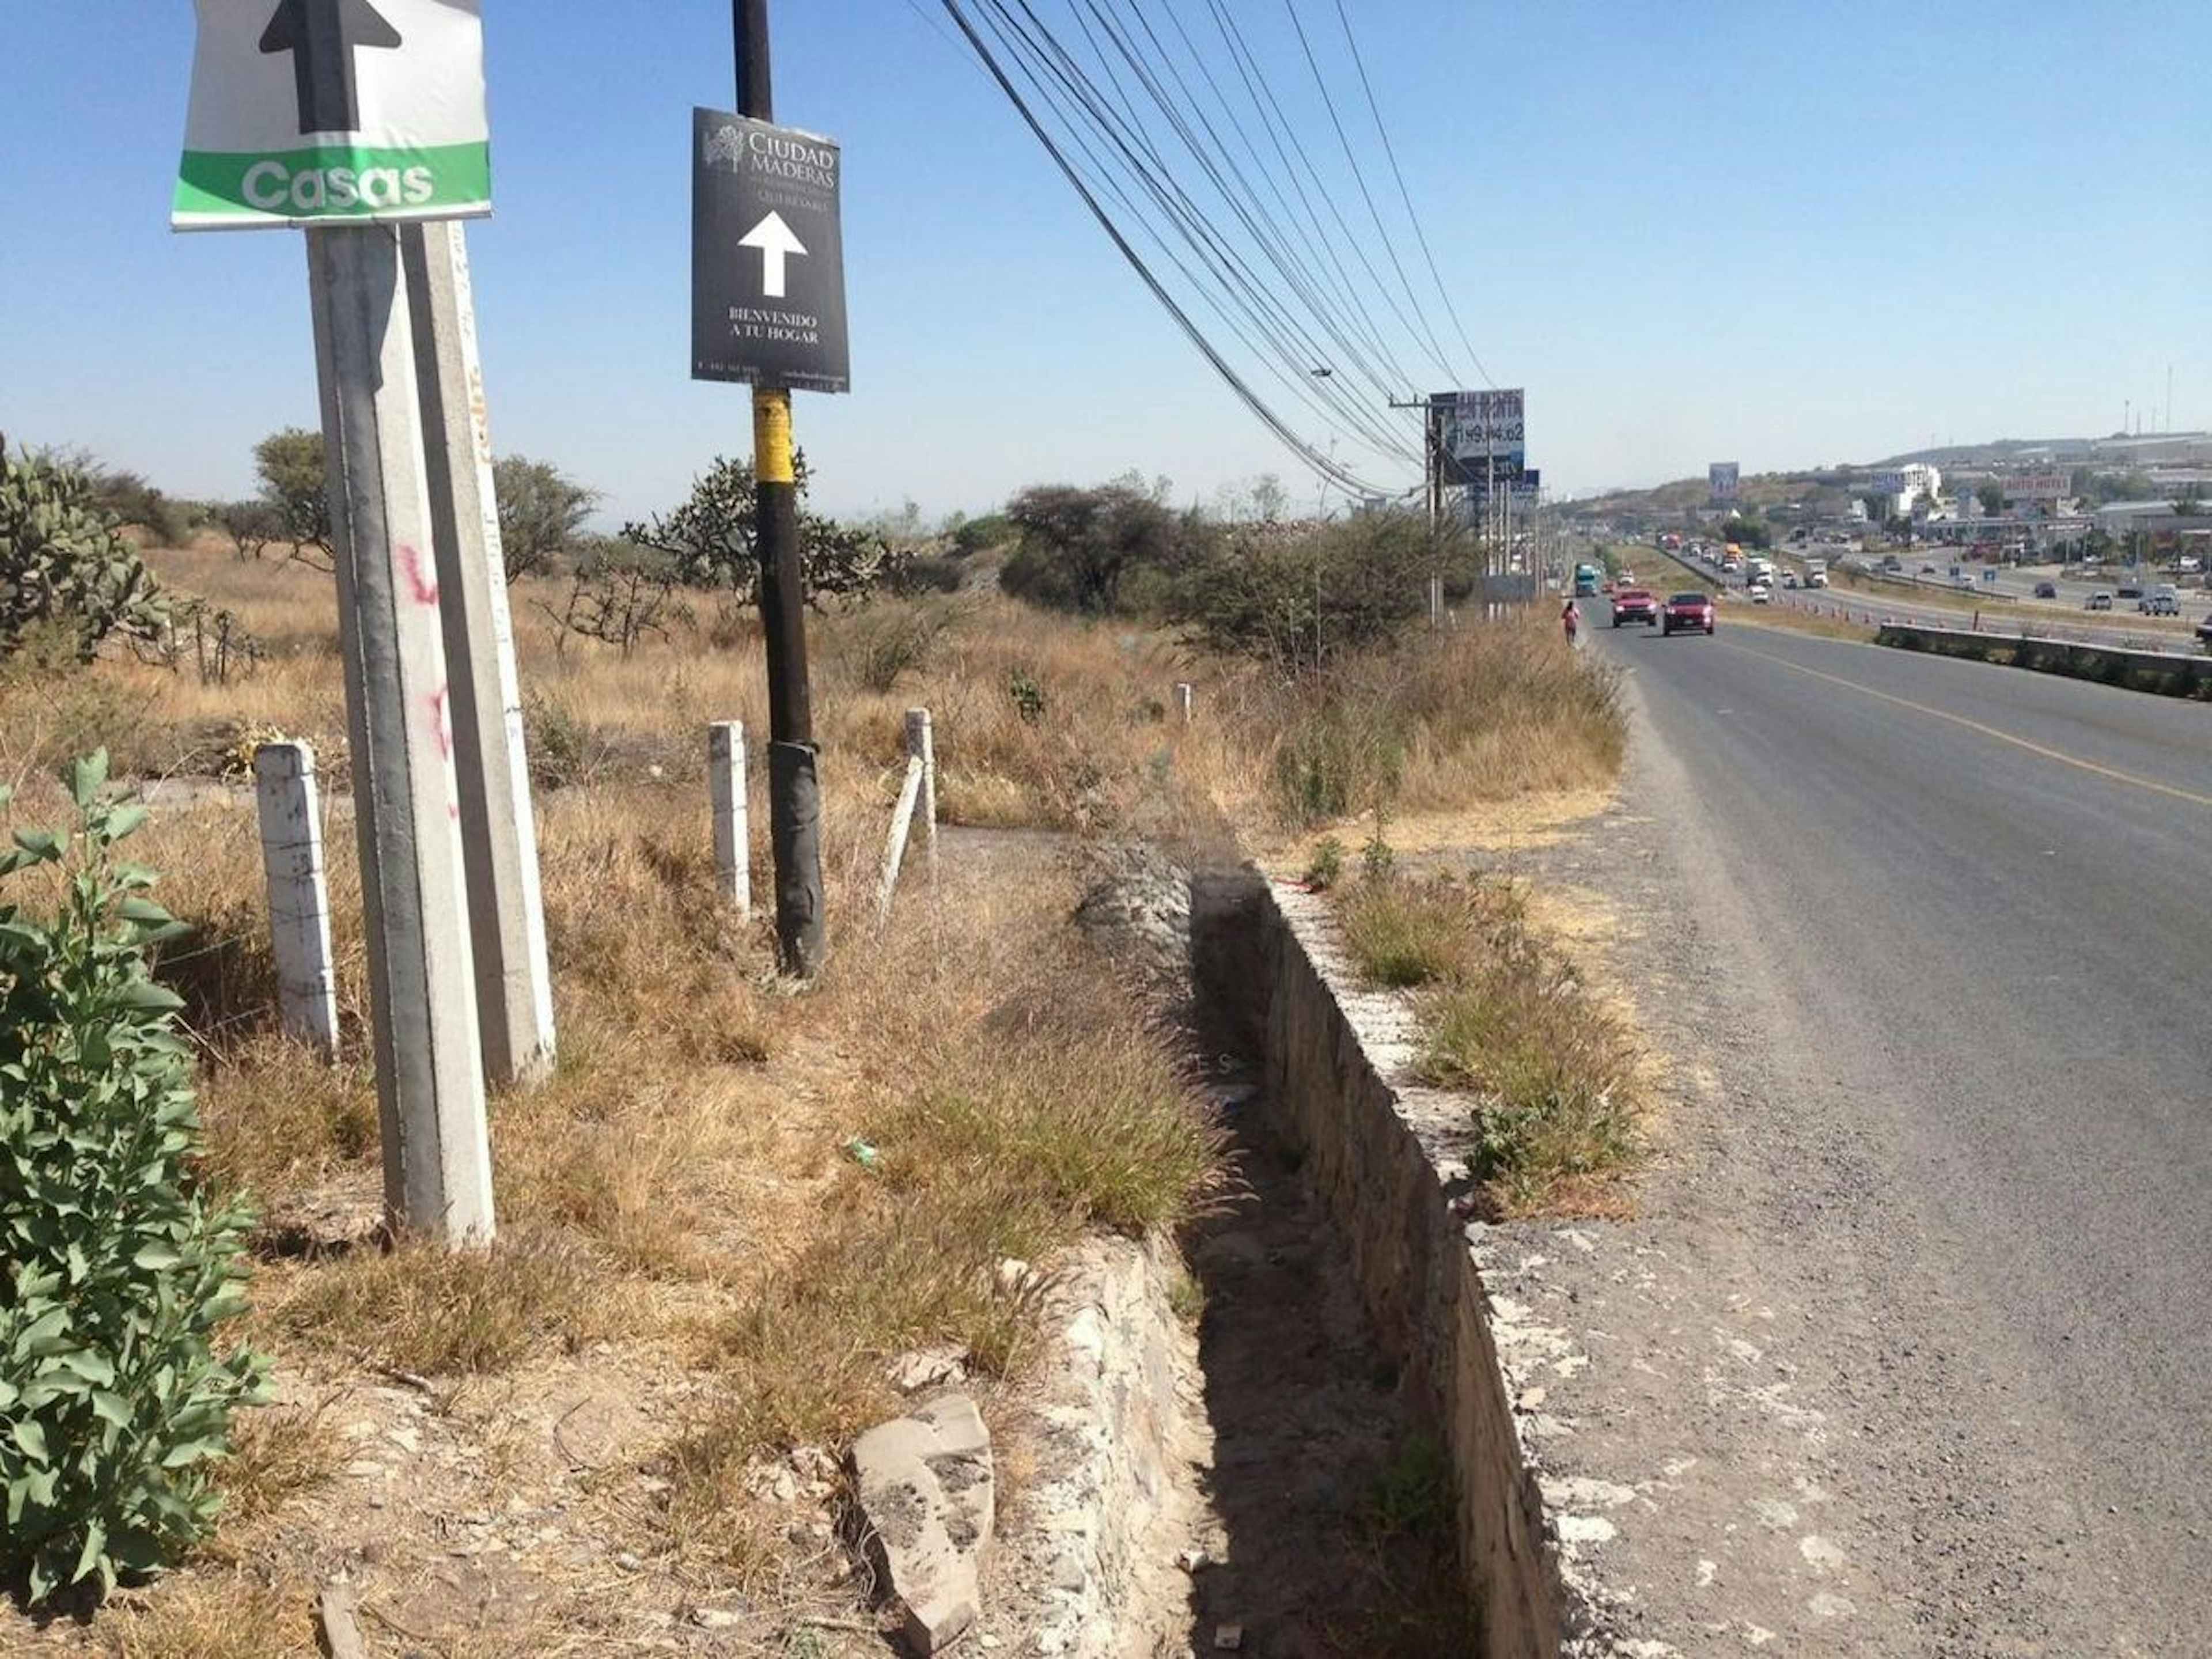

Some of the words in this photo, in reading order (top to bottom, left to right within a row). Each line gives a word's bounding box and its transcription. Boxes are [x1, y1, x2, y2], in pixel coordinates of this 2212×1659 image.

[749, 132, 834, 170] CIUDAD
[241, 161, 434, 210] Casas
[751, 153, 834, 188] MADERAS
[729, 306, 817, 328] BIENVENIDO
[730, 324, 740, 336] A
[744, 324, 765, 338] TU
[767, 327, 819, 344] HOGAR
